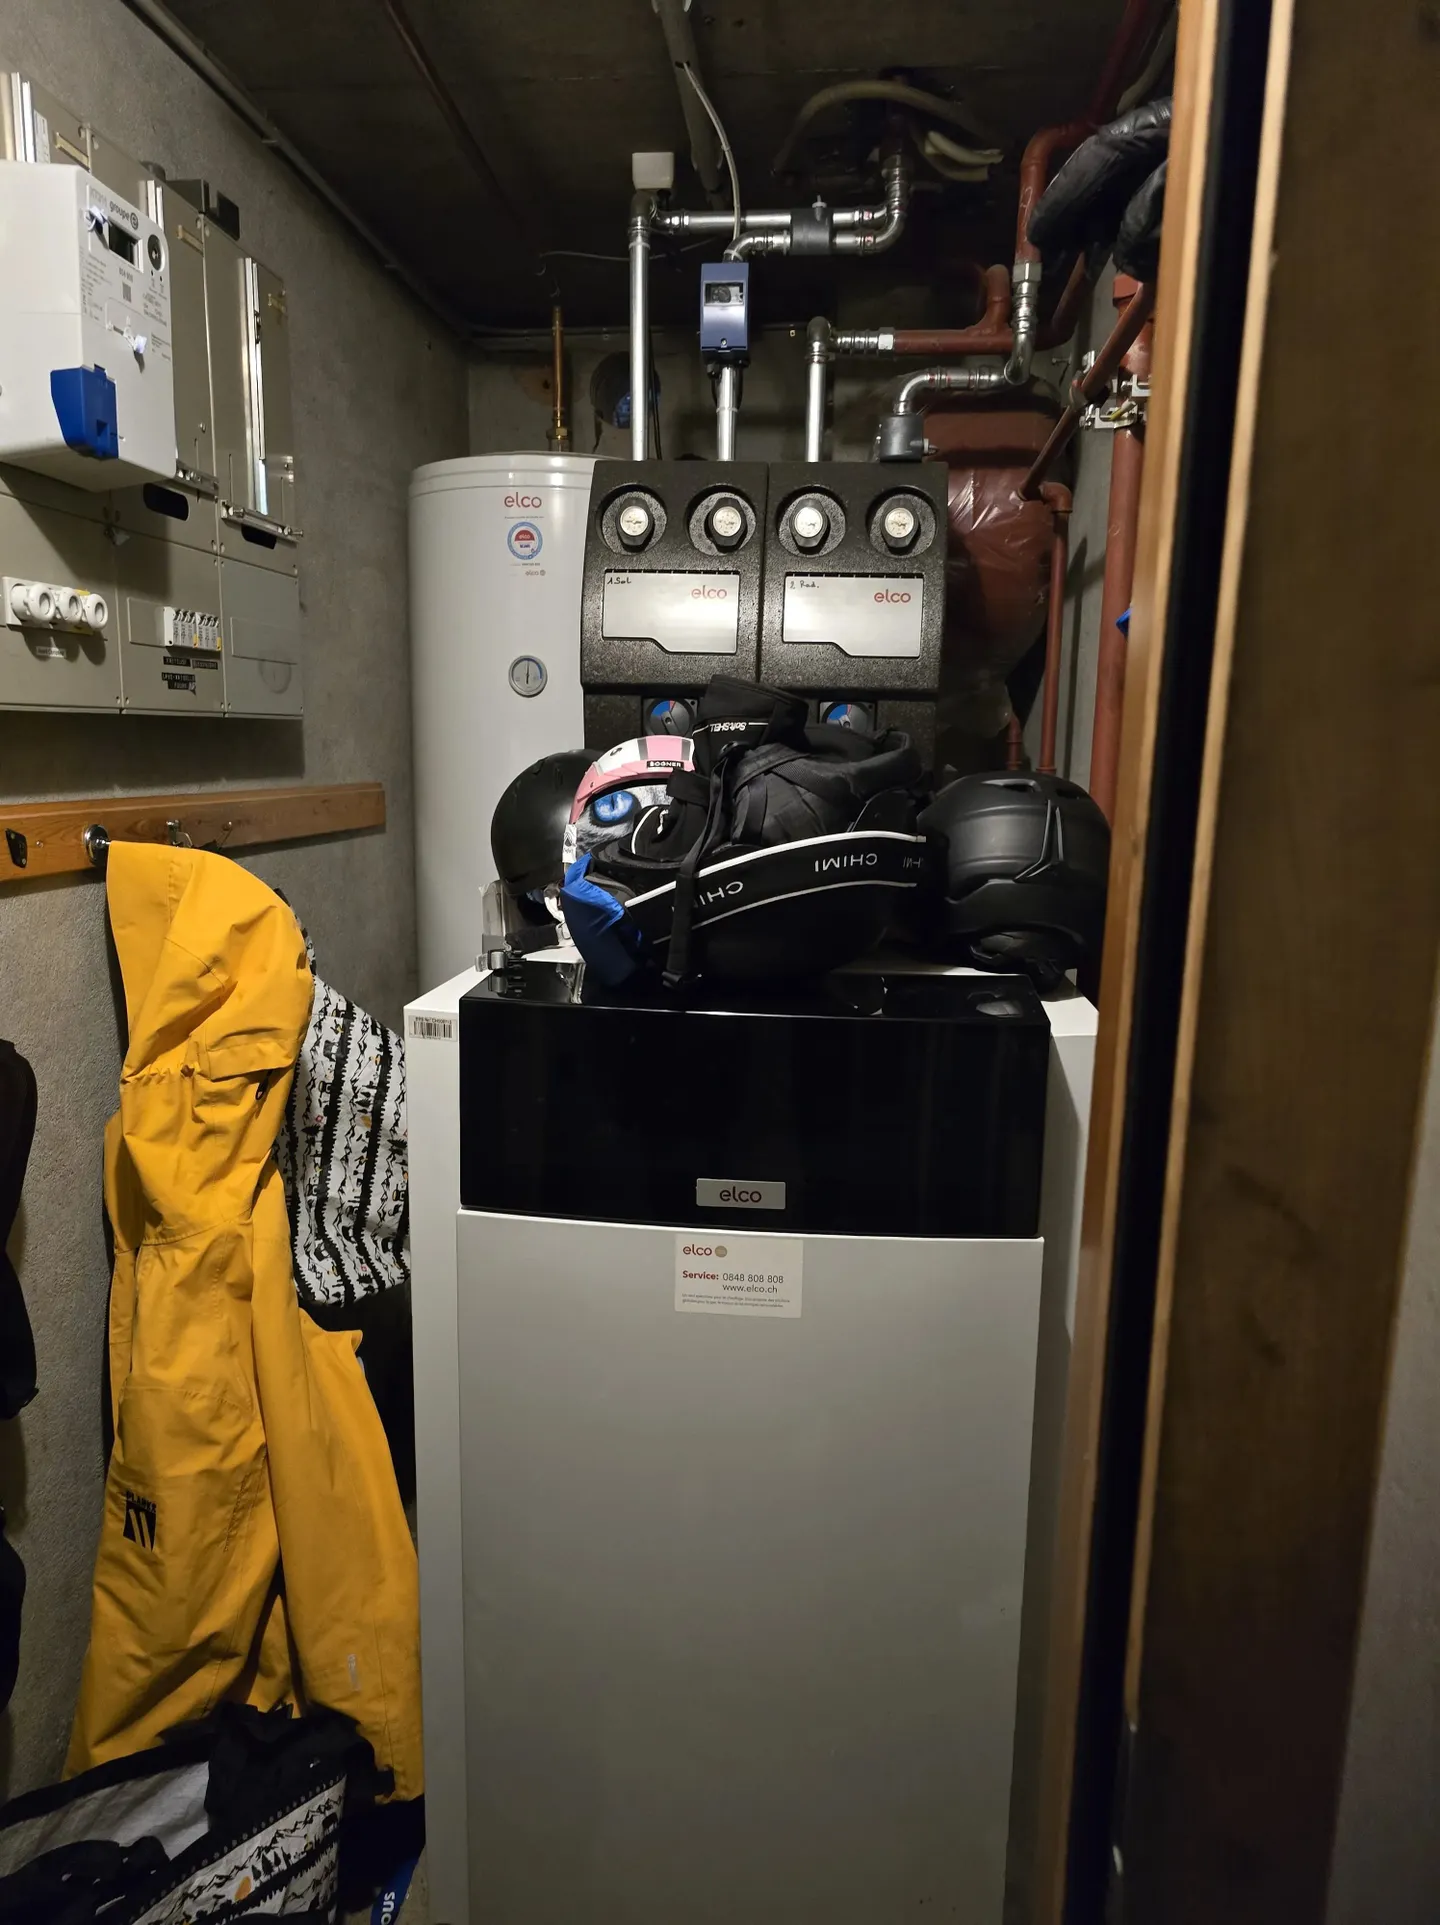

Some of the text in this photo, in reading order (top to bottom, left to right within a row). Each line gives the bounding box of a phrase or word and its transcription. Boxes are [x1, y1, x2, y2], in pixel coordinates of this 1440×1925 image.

[504, 491, 542, 508] elco
[691, 585, 727, 599] elco
[874, 589, 911, 603] elco
[814, 853, 878, 872] CHIMI
[719, 1186, 762, 1203] elco
[682, 1244, 713, 1256] elco
[682, 1270, 784, 1284] Service: 0848 808 808
[722, 1284, 778, 1294] www.elco.ch
